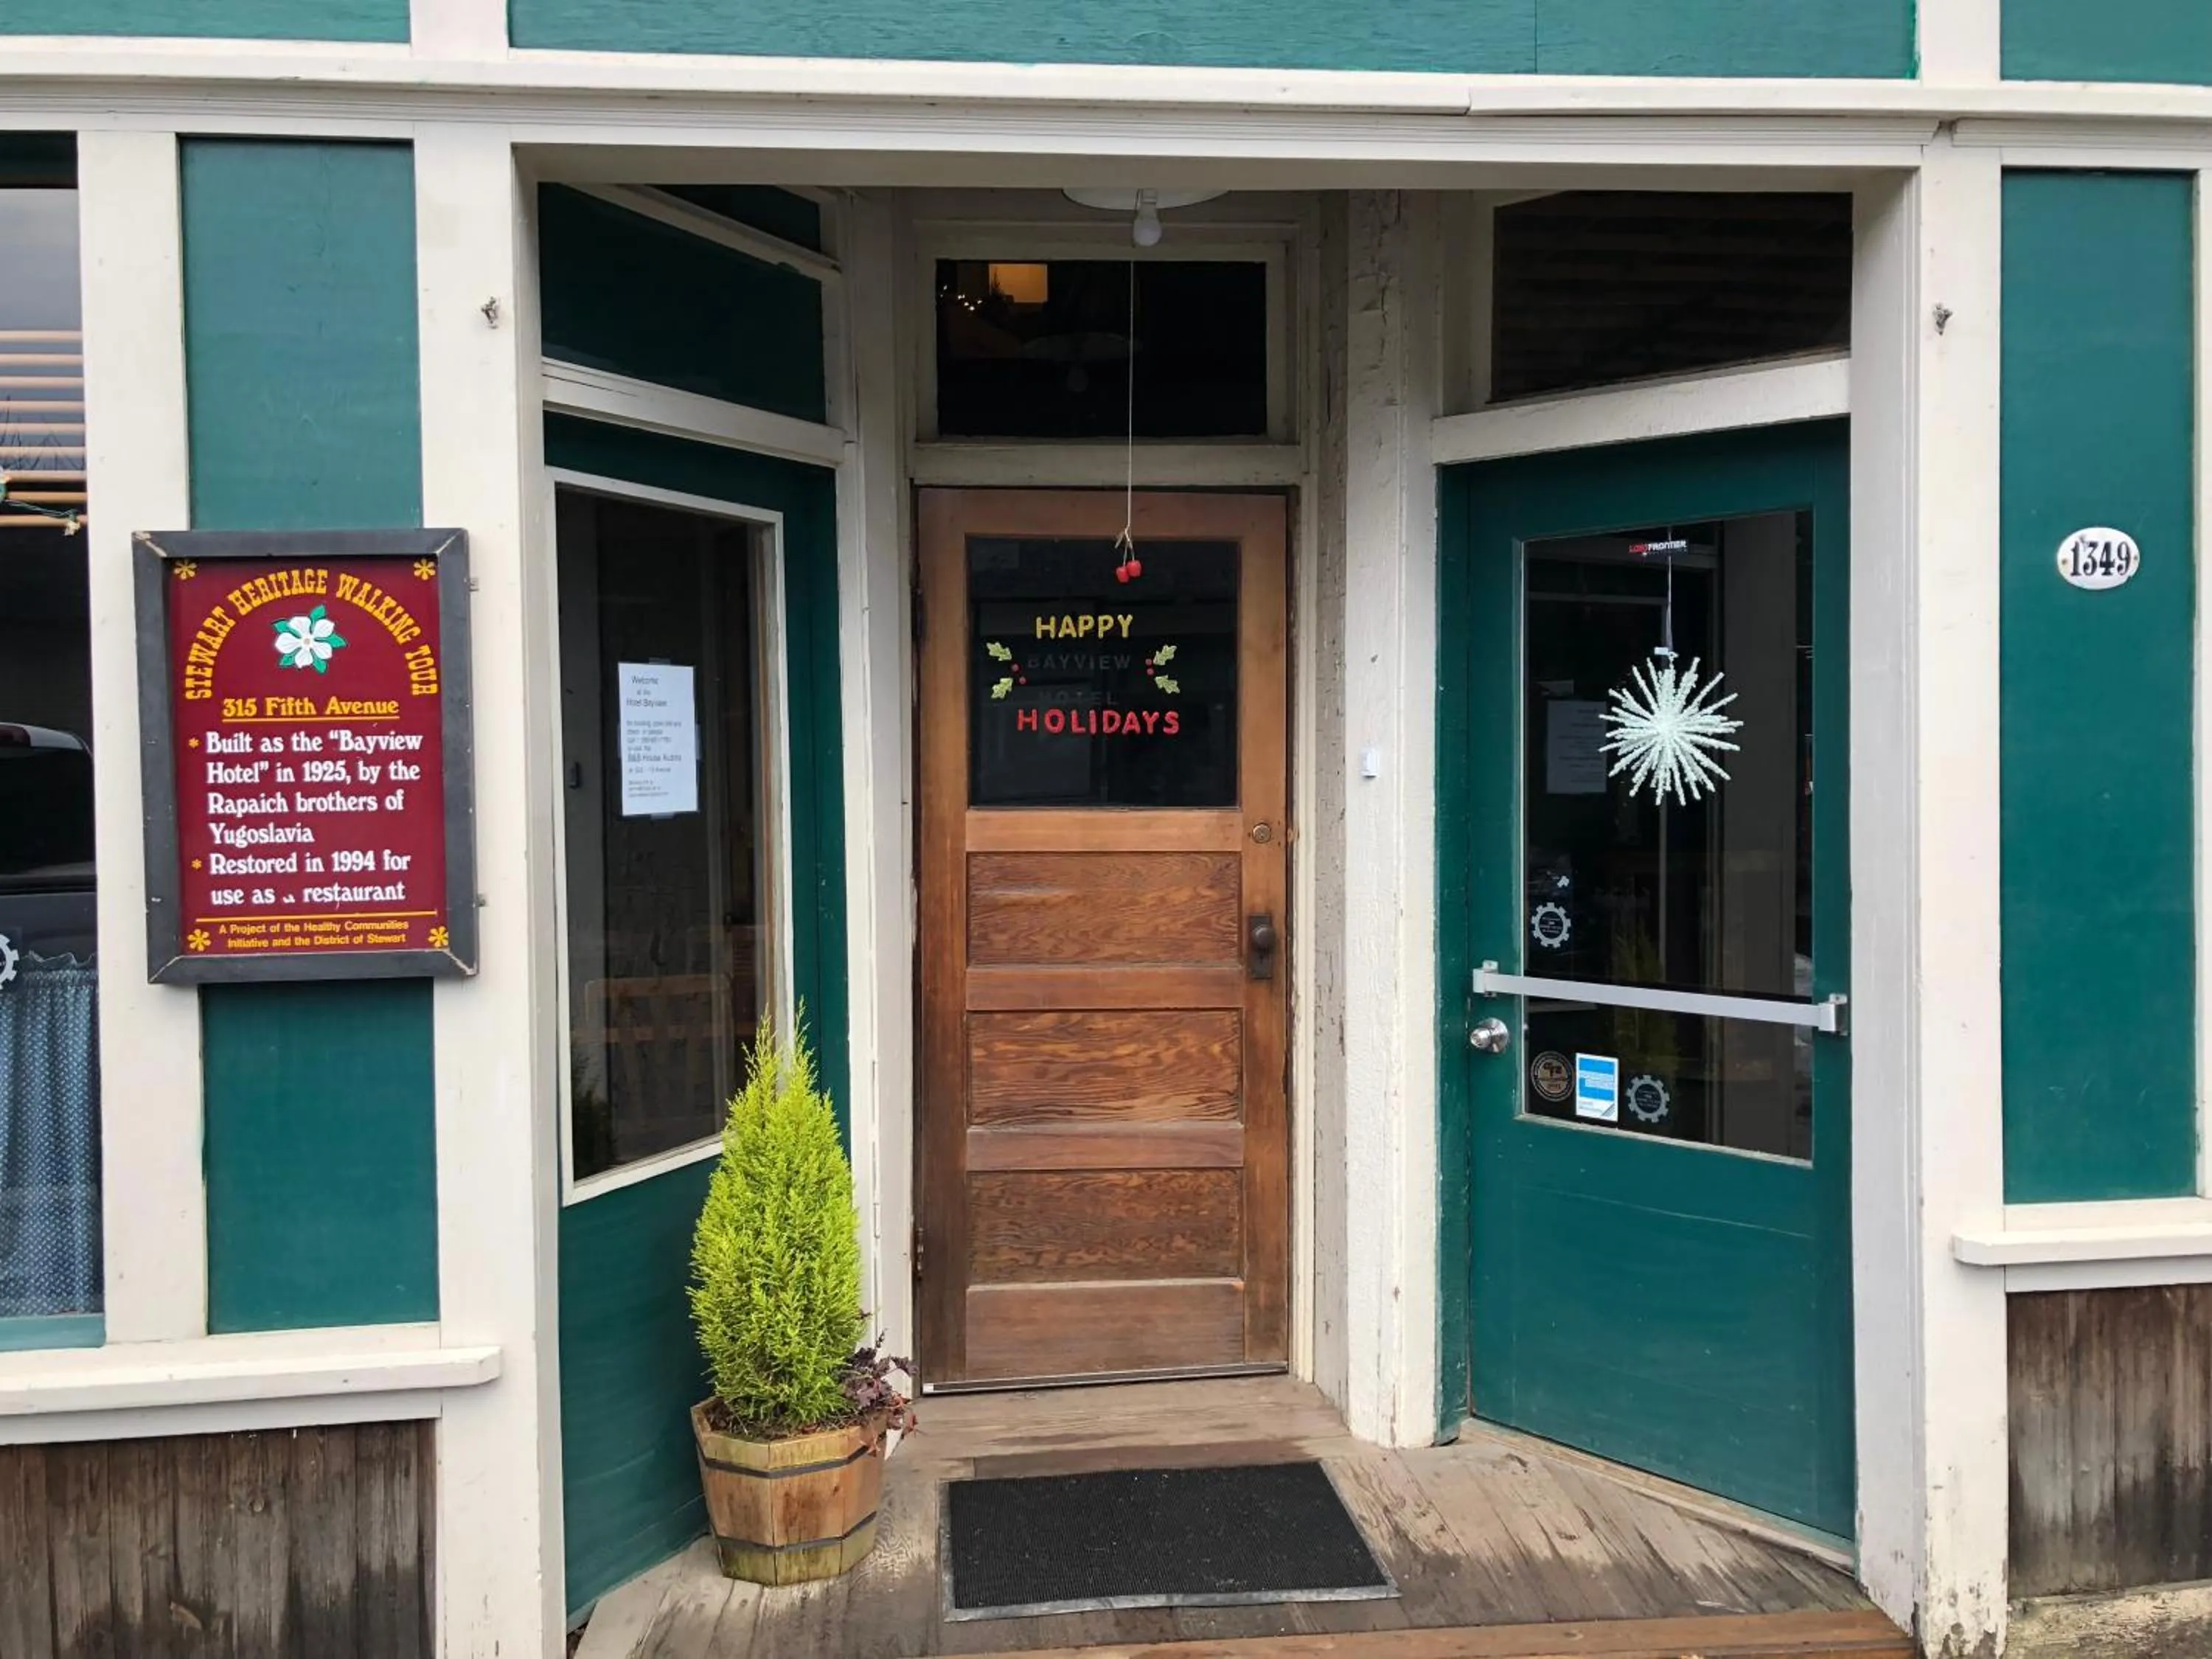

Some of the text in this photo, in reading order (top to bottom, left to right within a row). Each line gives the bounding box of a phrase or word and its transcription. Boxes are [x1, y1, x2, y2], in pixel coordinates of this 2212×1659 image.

[2070, 541, 2131, 576] 1349
[185, 569, 437, 699] STEWART HERITAGE WALKING TOUR
[1035, 614, 1133, 638] HAPPY
[223, 697, 398, 717] 315 Fifth Avenue
[1017, 709, 1179, 734] HOLIDAYS
[206, 731, 253, 753] Built
[260, 737, 284, 752] as
[291, 732, 322, 751] the
[276, 762, 295, 782] in
[303, 760, 350, 784] 1925,
[358, 761, 380, 784] by
[389, 760, 420, 779] the
[208, 789, 404, 817] Rapaich brothers of
[209, 823, 314, 848] Yugoslavia
[210, 849, 411, 874] Restored in 1994 for
[212, 889, 243, 905] use
[252, 889, 275, 904] as
[304, 882, 405, 903] restaurant
[219, 920, 408, 935] A Project of the Healthy Communities
[228, 933, 406, 947] Initiative and the District of Stewart
